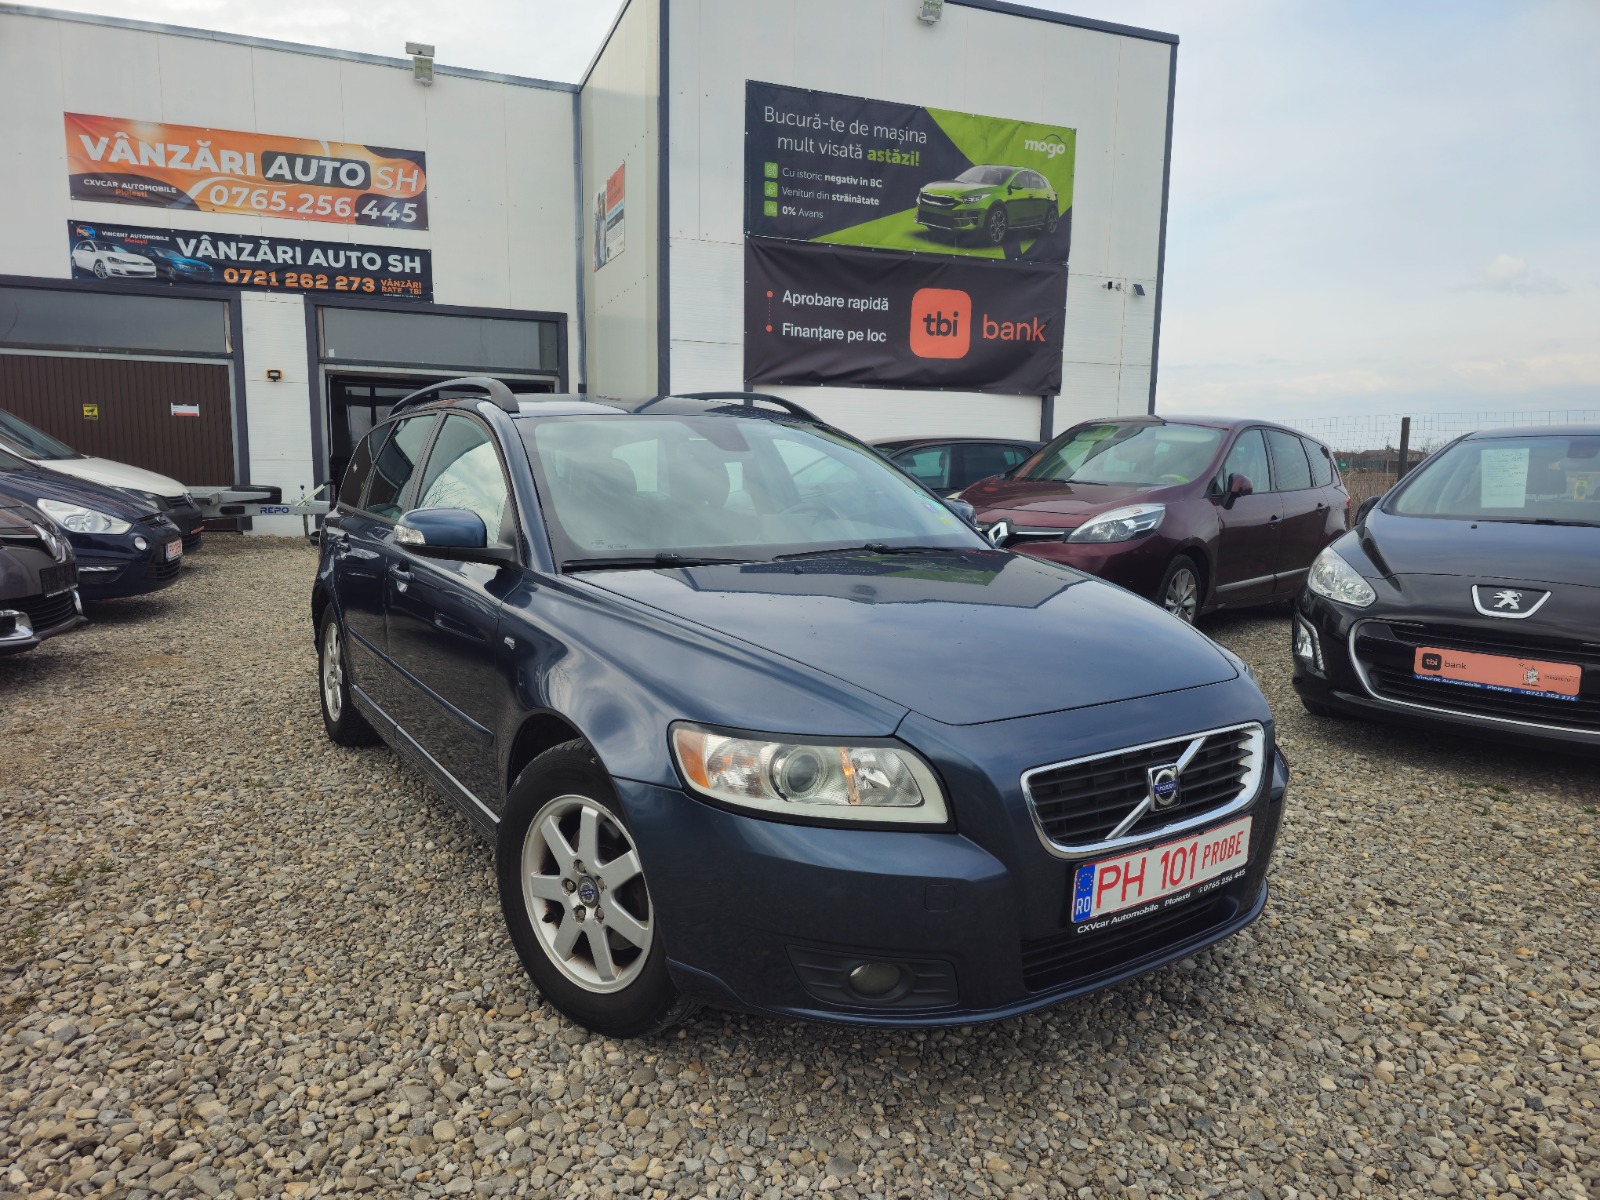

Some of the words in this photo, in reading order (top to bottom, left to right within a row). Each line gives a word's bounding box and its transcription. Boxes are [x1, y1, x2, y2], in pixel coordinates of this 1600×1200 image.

[764, 106, 845, 133] Bucură-te
[849, 120, 869, 136] de
[873, 125, 927, 145] mașina
[777, 136, 815, 153] mult
[818, 140, 863, 159] visată
[867, 148, 920, 166] astăzi!
[1024, 139, 1066, 159] mogo
[79, 131, 256, 177] VÂNZĂRI
[265, 155, 366, 187] AUTO
[374, 166, 419, 192] SH
[83, 178, 119, 188] CXVCAR
[121, 182, 177, 194] AUTOMOBILE
[782, 167, 795, 177] Cu
[797, 169, 823, 180] istoric
[824, 174, 858, 185] negativ
[859, 177, 868, 186] in
[870, 178, 883, 188] BC
[209, 184, 418, 223] 0765.256.445
[781, 186, 815, 199] Venituri
[816, 191, 830, 200] din
[831, 193, 880, 206] străinătate
[782, 205, 797, 216] 0%
[797, 208, 824, 219] Avans
[101, 230, 129, 238] VINCENT
[129, 233, 170, 241] AUTOMOBILE
[176, 234, 302, 265] VÂNZĂRI
[307, 248, 382, 271] AUTO
[387, 254, 422, 274] SH
[223, 267, 279, 287] 0721
[284, 272, 329, 290] 262
[335, 275, 376, 293] 273
[380, 277, 422, 289] VÂNZĂRI
[381, 286, 402, 294] RATE
[782, 289, 845, 308] Aprobare
[847, 297, 889, 312] rapidă
[782, 322, 845, 341] Finanțare
[847, 330, 864, 343] pe
[866, 328, 887, 343] loc
[922, 311, 959, 338] tbi
[982, 314, 1046, 342] bank
[260, 506, 290, 514] REPO
[1425, 658, 1438, 666] tbi
[1444, 661, 1467, 670] bank
[1075, 897, 1091, 915] RO
[1096, 856, 1147, 910] PH
[1160, 841, 1199, 890] 101
[1201, 830, 1245, 870] PROBE
[1077, 919, 1110, 934] CXVcar
[1111, 903, 1160, 924] Automobile
[1203, 881, 1221, 893] 0765
[1220, 875, 1233, 885] 256
[1233, 868, 1246, 879] 445
